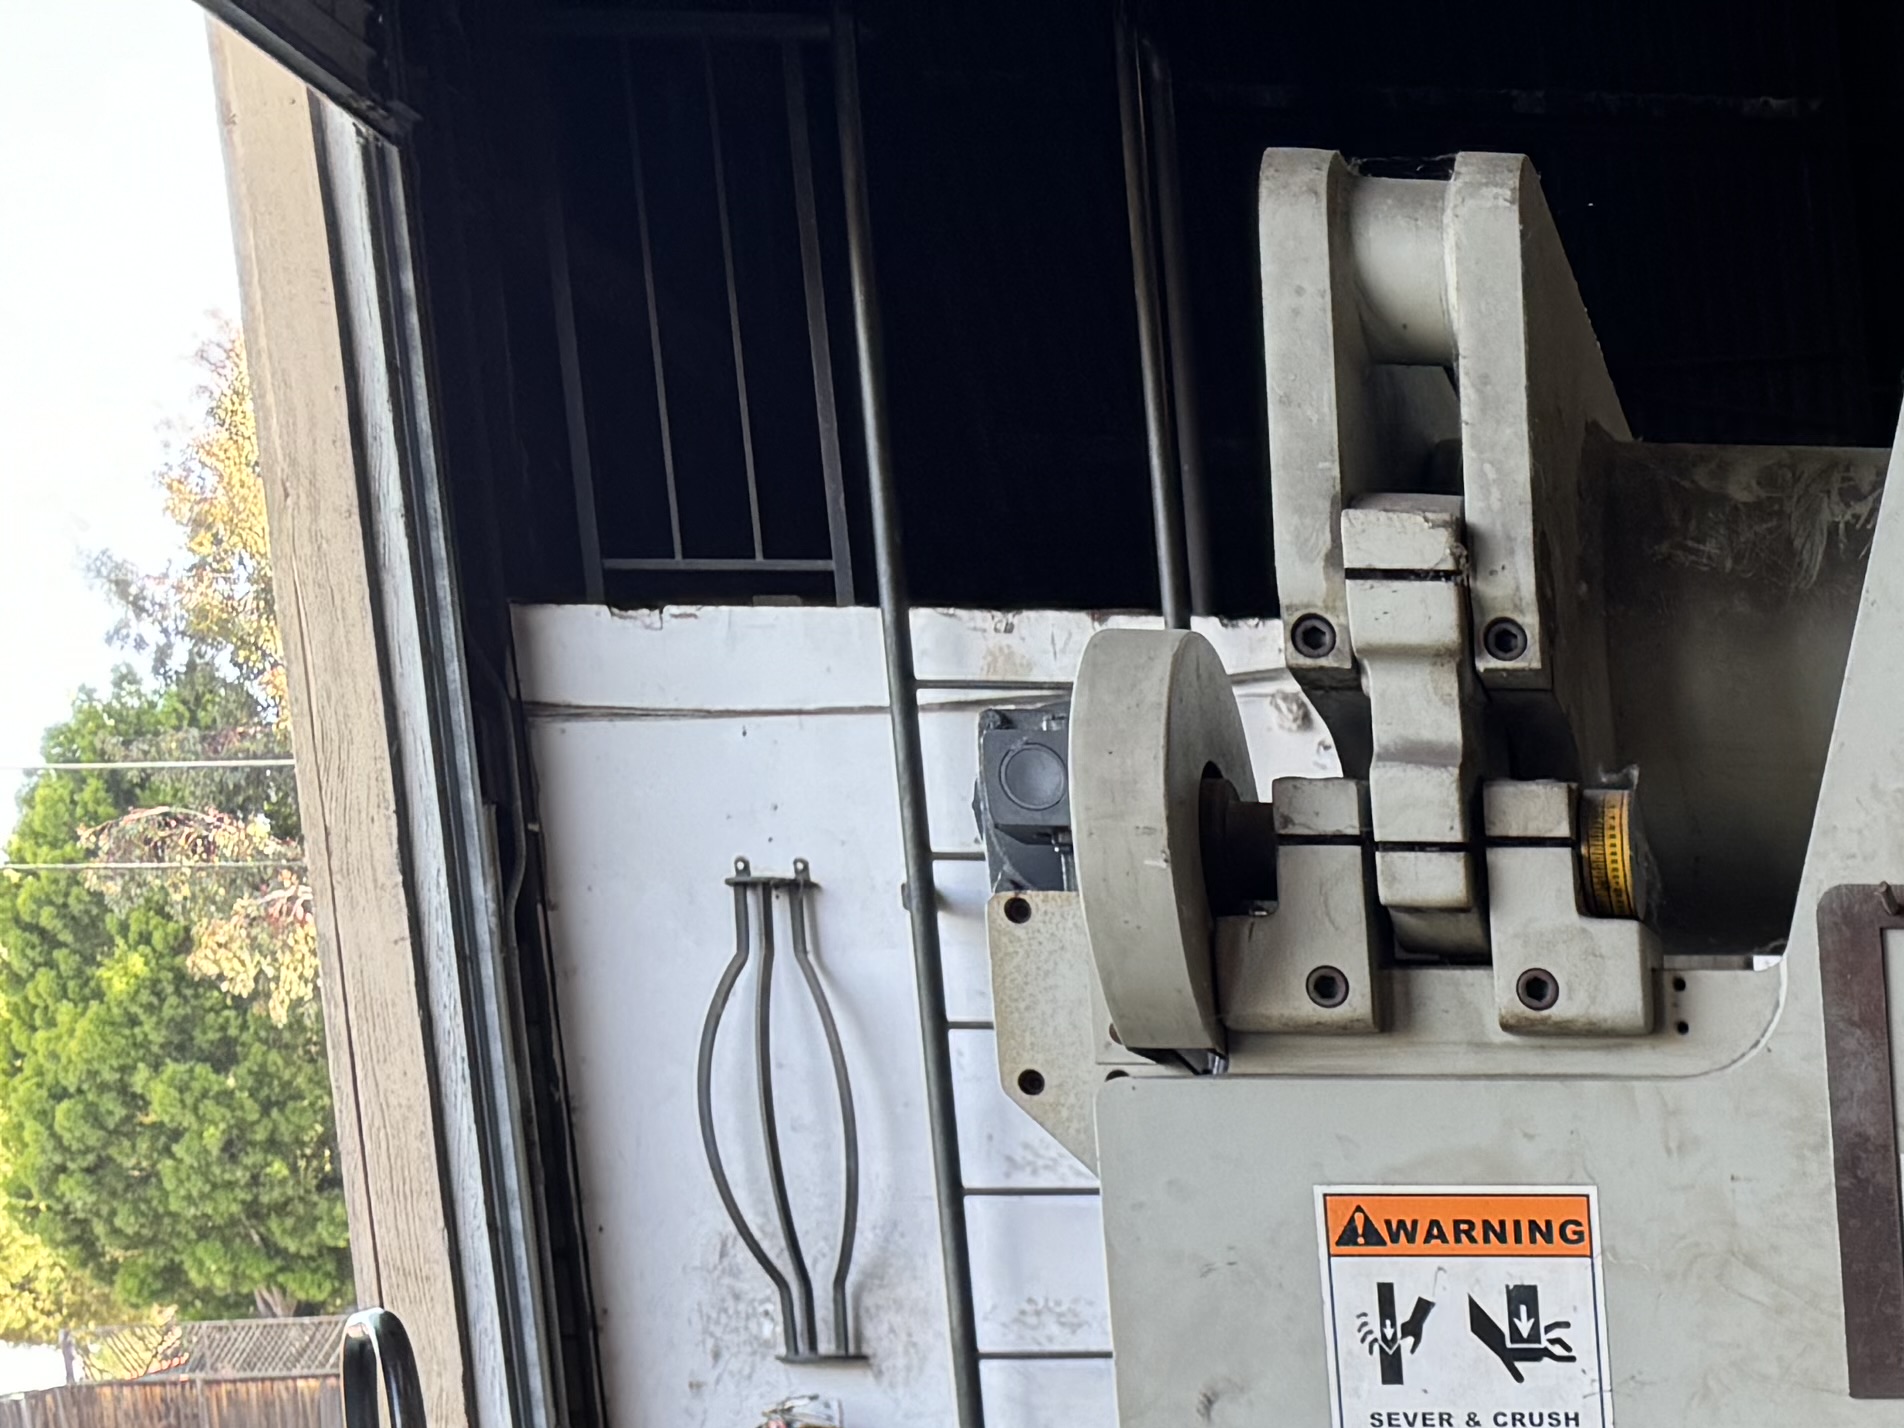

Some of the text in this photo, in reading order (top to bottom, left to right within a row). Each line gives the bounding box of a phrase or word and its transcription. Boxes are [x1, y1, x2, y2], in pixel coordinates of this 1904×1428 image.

[1385, 1219, 1586, 1244] WARNING
[1370, 1411, 1579, 1427] SEVER & CRUSH
